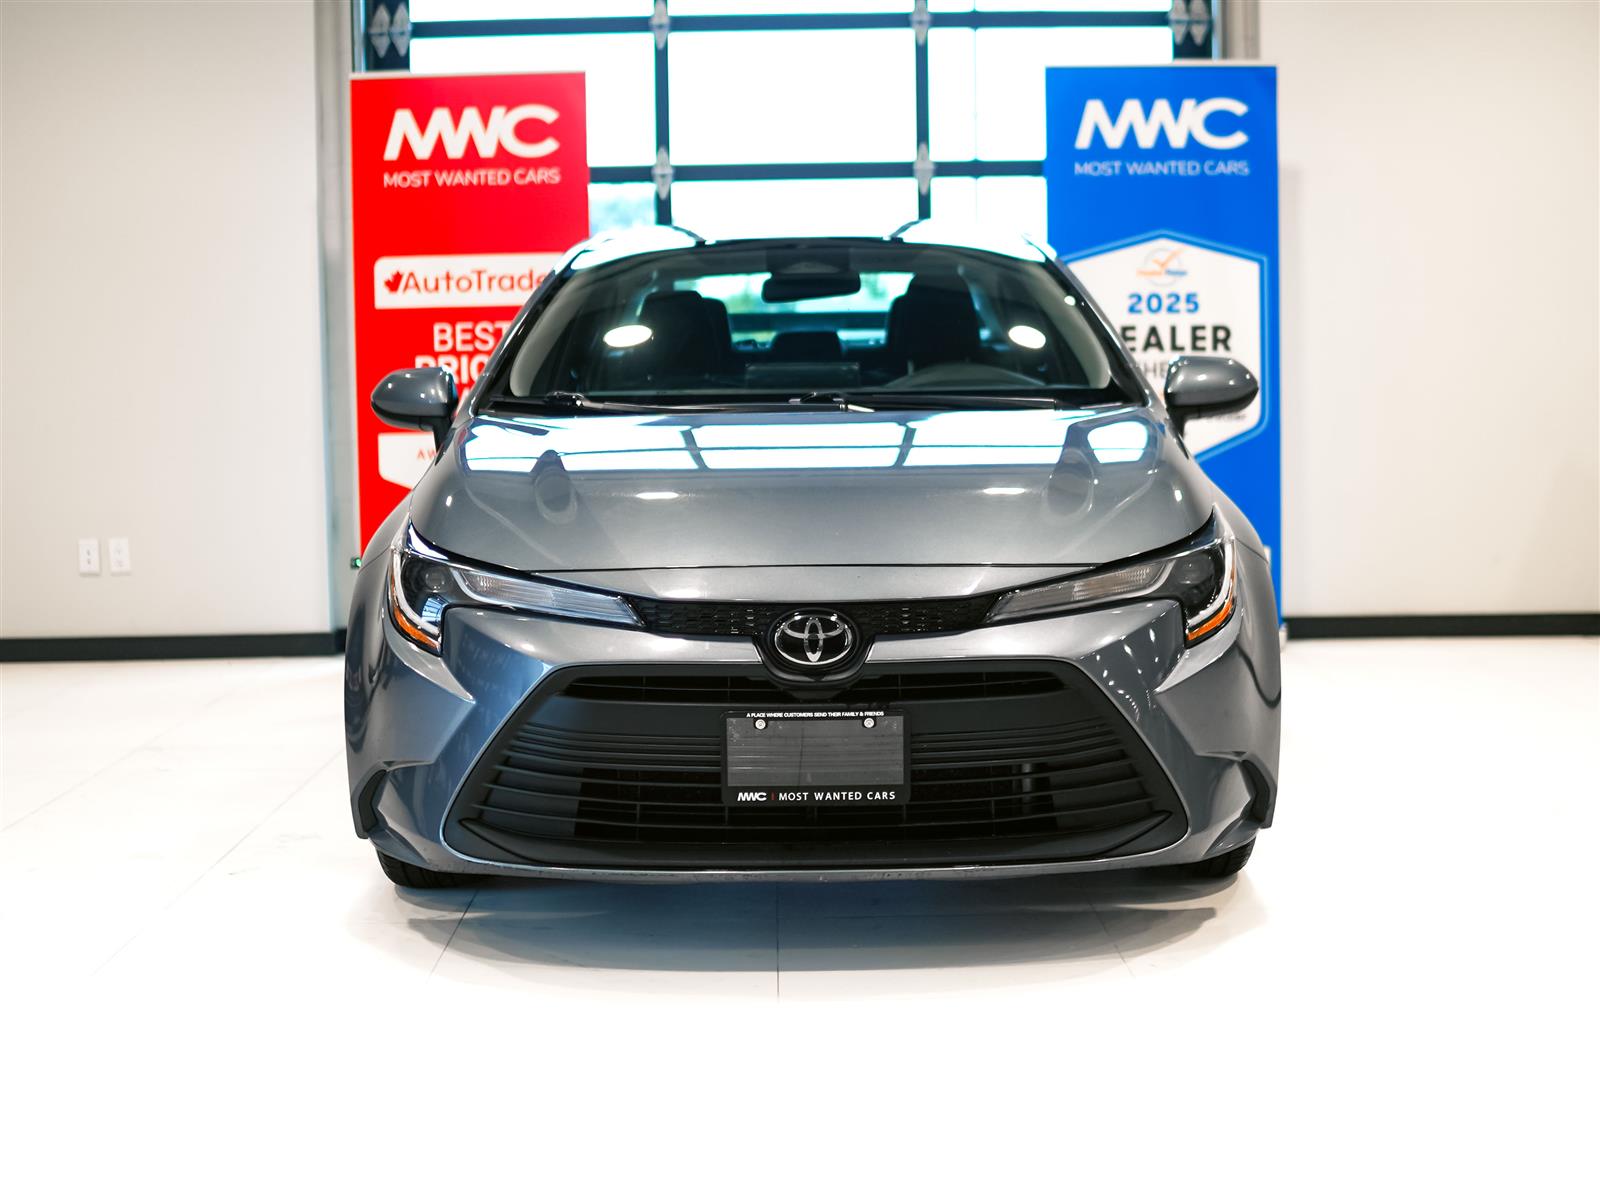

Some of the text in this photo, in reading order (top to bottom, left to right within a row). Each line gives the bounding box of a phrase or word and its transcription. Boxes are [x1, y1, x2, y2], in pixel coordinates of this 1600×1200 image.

[383, 104, 560, 162] MWC
[1074, 97, 1249, 150] MWC
[383, 166, 562, 189] MOST WANTED CARS
[1074, 160, 1250, 176] MOST WANTED CARS
[402, 269, 547, 294] AutoTrad
[1127, 292, 1200, 314] 2025
[433, 320, 513, 352] BEST
[1120, 325, 1232, 352] EALER
[738, 791, 896, 802] MWC MOST WANTED CARS
